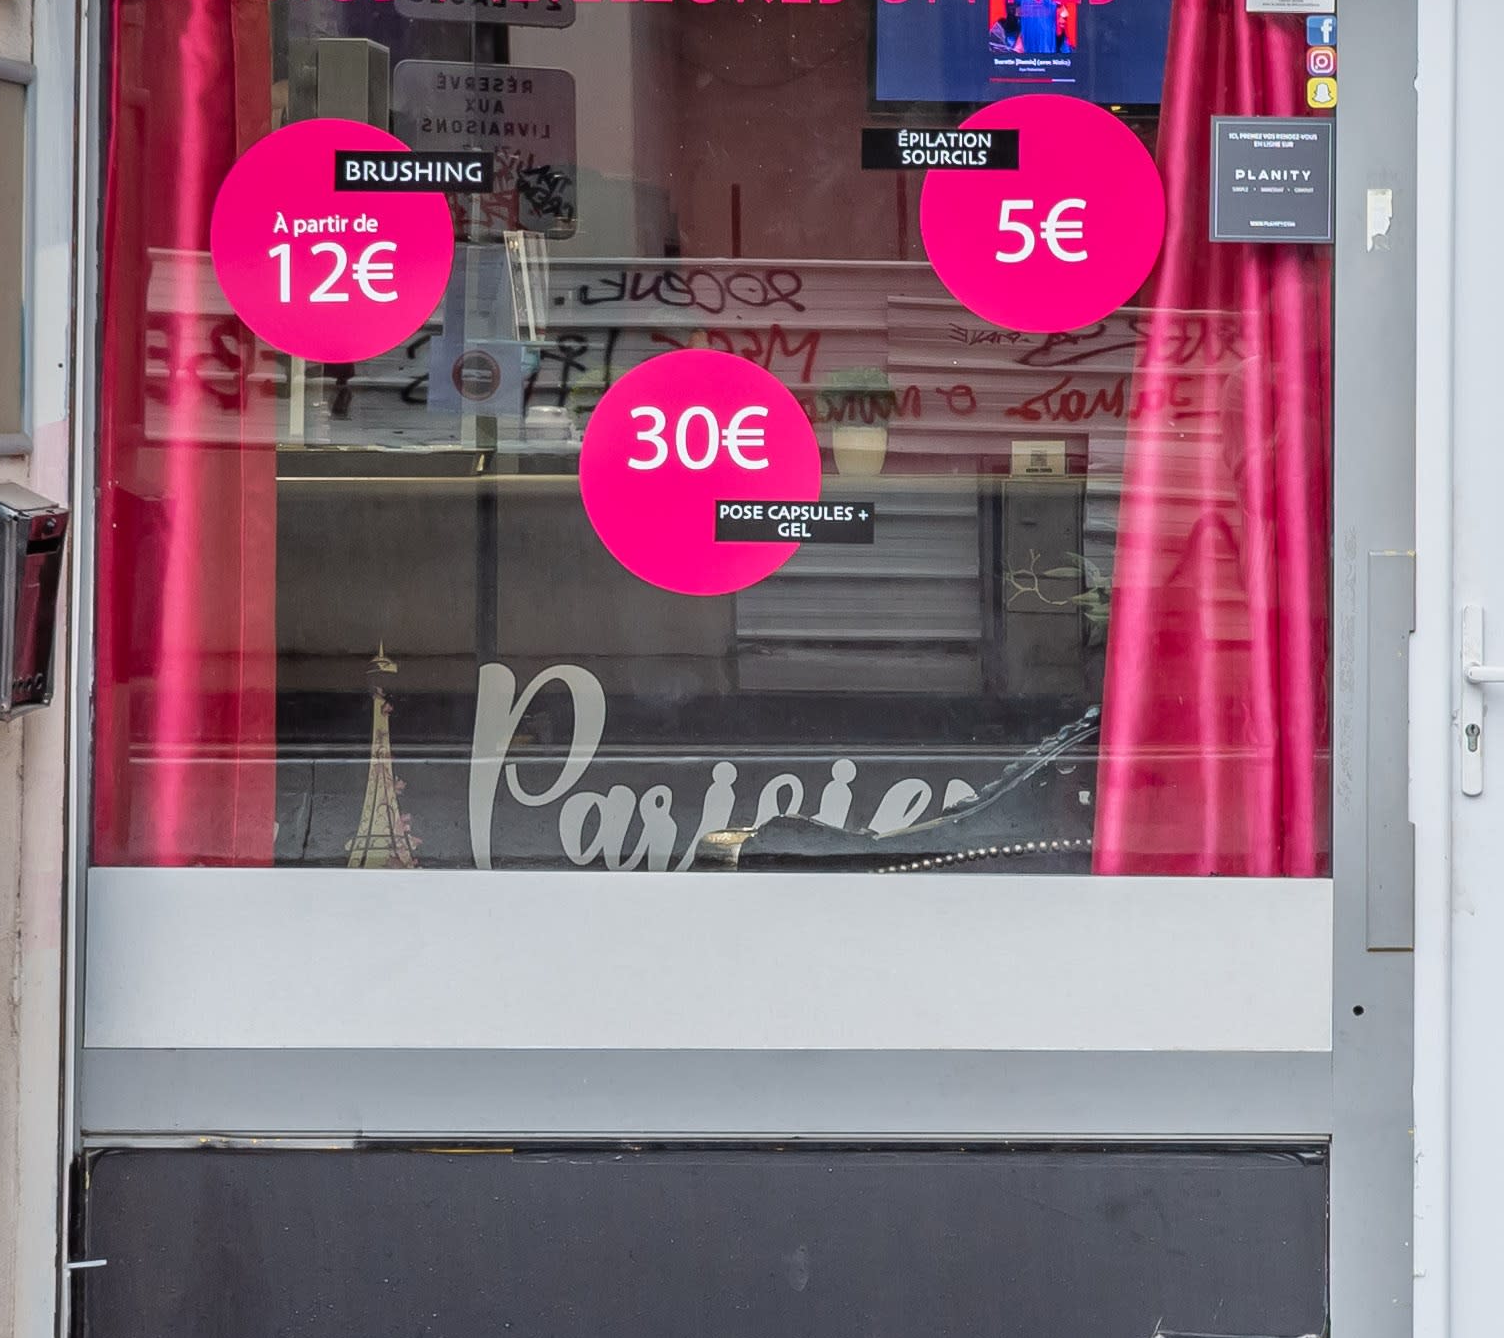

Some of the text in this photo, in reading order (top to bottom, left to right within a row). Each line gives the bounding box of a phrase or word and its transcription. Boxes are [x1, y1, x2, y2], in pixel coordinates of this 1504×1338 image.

[898, 129, 992, 148] ÉPILATION
[902, 149, 987, 166] SOURCILS
[346, 160, 482, 182] BRUSHING
[1235, 169, 1311, 181] PLANITY
[273, 211, 379, 238] À partir de
[995, 198, 1088, 263] 5€
[268, 241, 399, 303] 12€
[627, 405, 769, 470] 30€
[719, 504, 869, 521] POSE CAPSULES +
[777, 522, 812, 538] GEL
